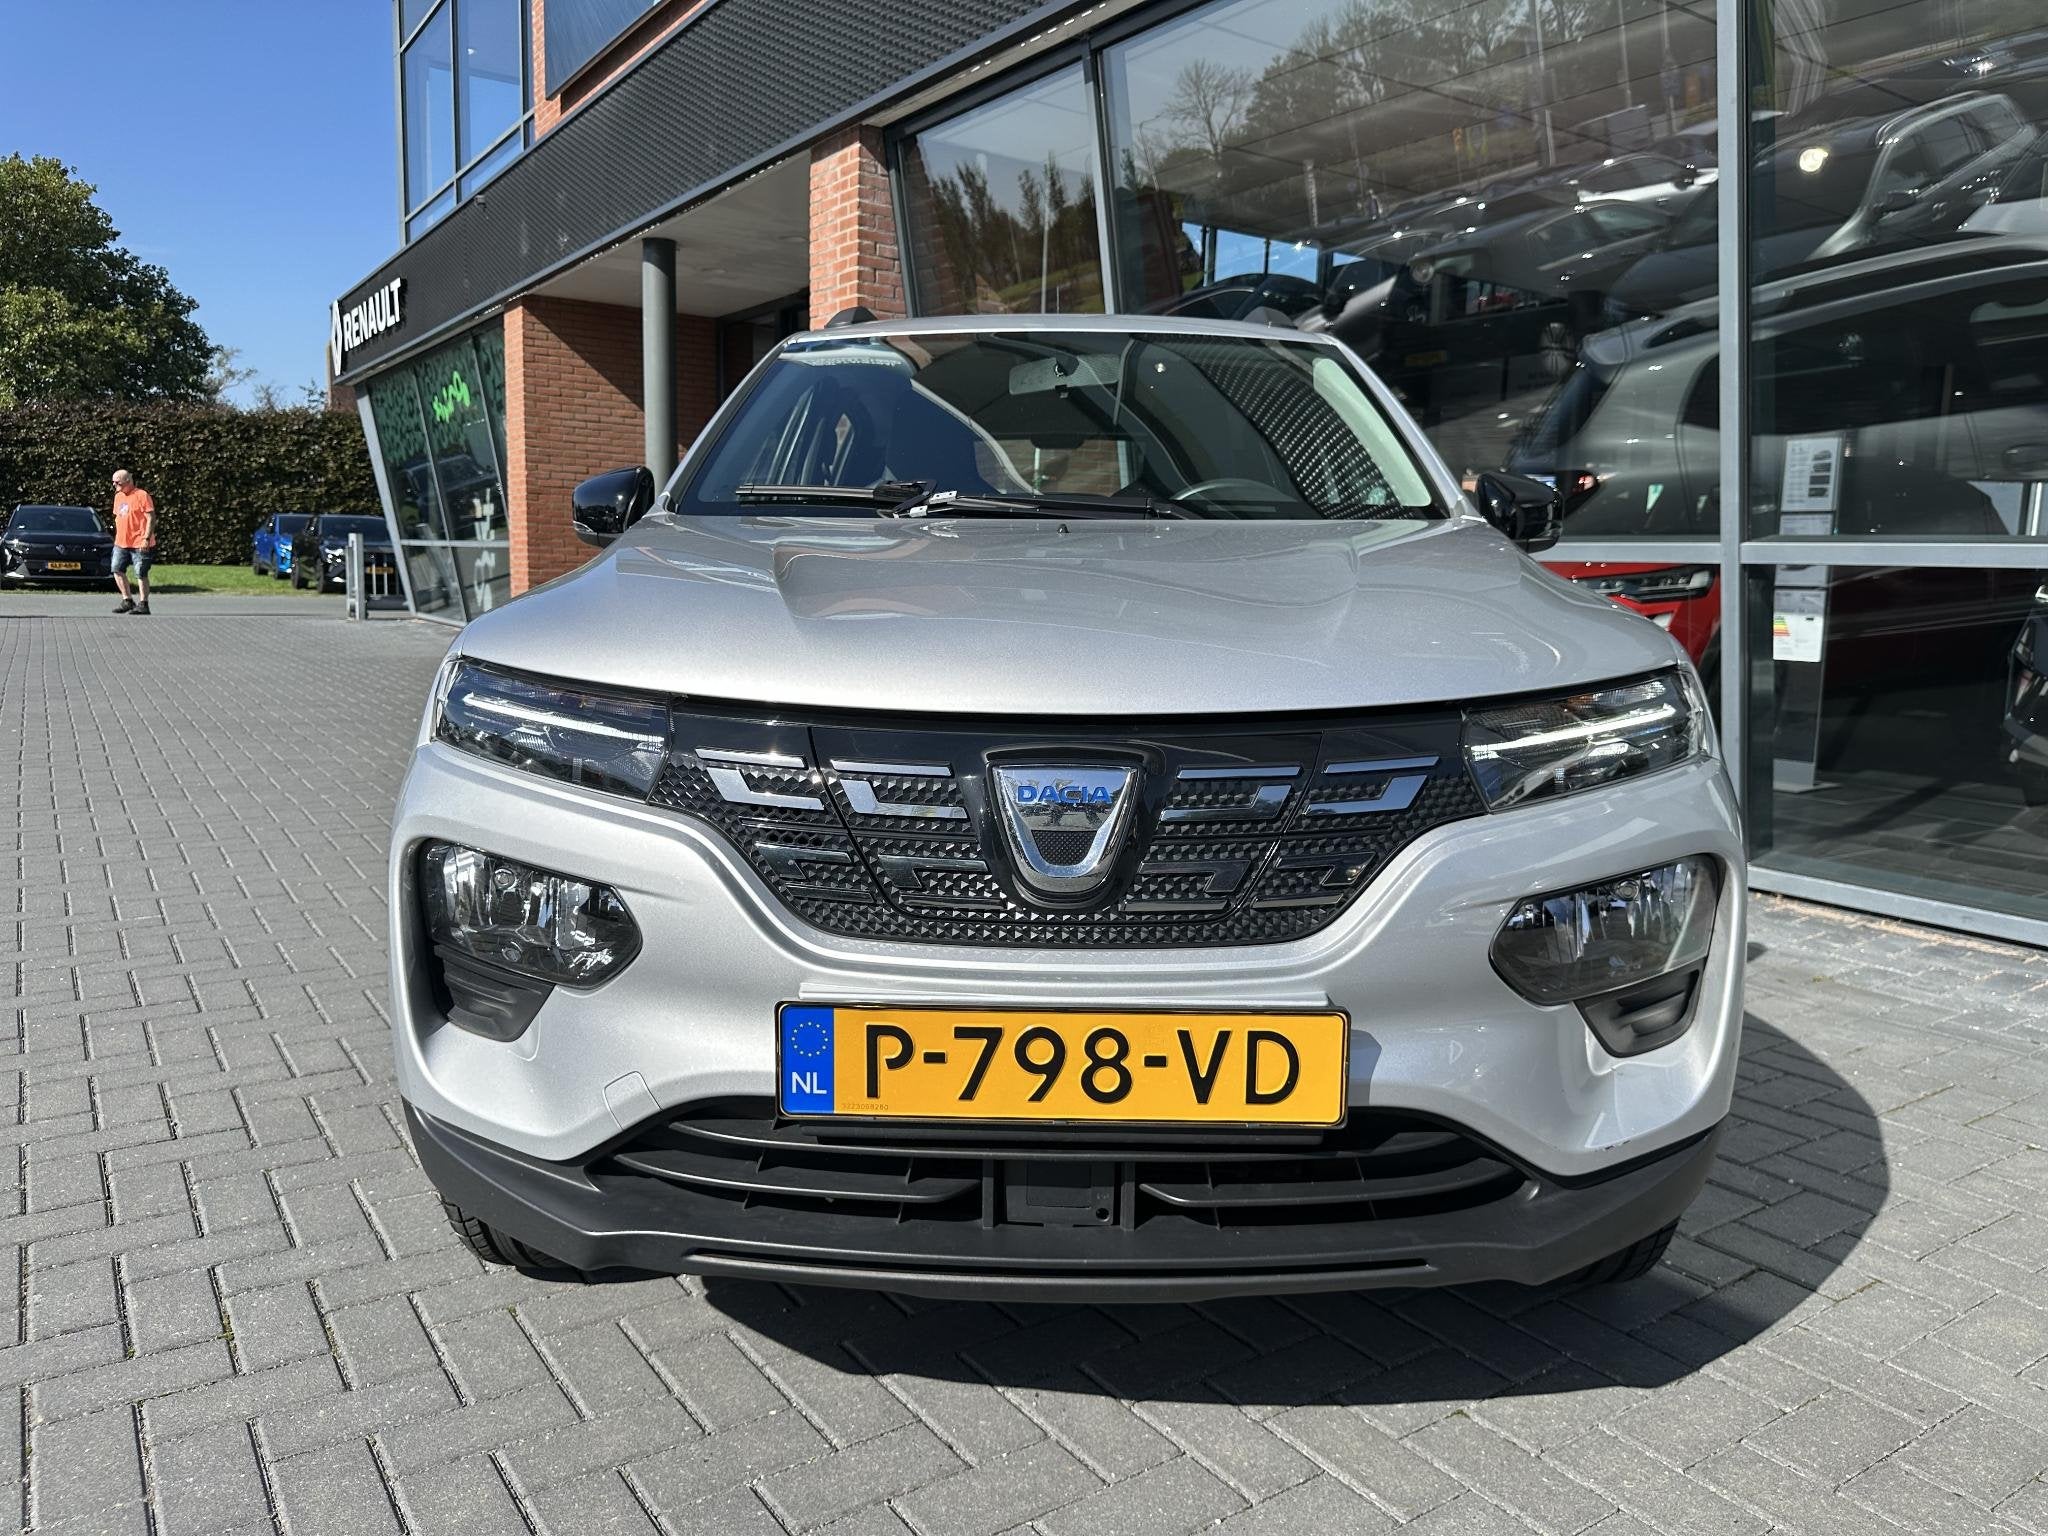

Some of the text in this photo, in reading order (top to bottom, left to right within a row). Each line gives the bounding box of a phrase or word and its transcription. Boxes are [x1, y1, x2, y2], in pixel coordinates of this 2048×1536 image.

[343, 277, 401, 351] RENAULT
[1017, 785, 1113, 805] DACIA
[791, 1071, 828, 1095] NL
[866, 1024, 1300, 1104] P-798-VD
